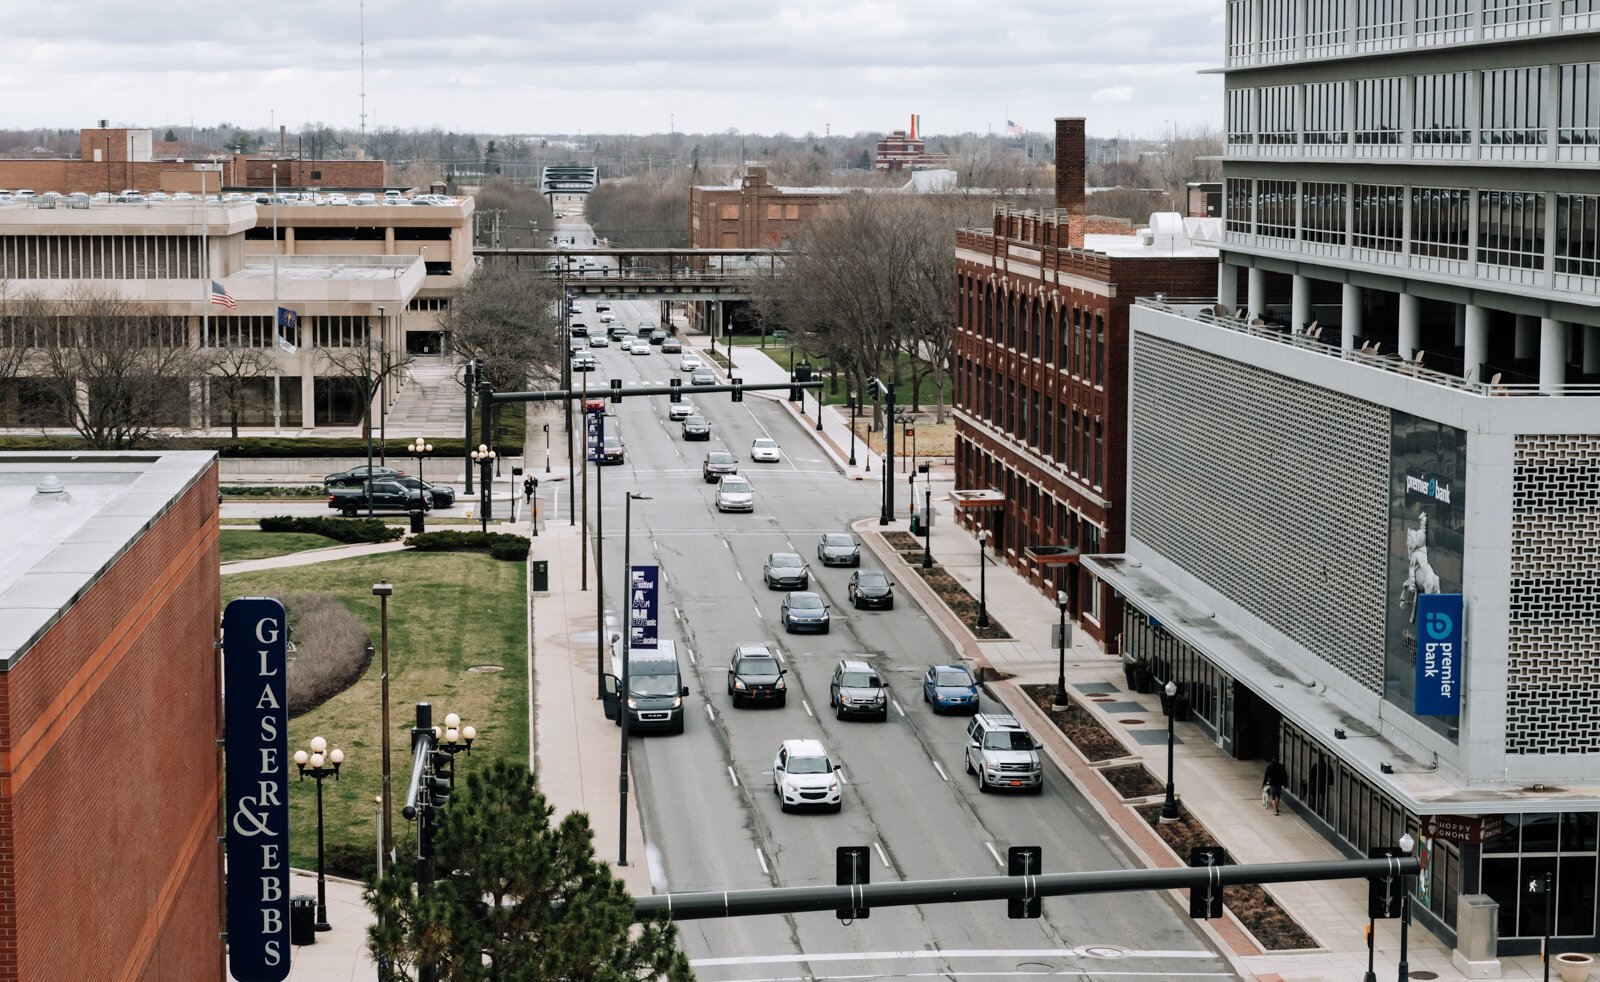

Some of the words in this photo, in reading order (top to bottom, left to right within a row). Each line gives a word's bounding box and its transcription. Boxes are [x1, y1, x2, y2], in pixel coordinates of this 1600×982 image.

[1406, 475, 1430, 495] premier
[1435, 479, 1451, 504] bank
[1424, 642, 1439, 678] bank
[1440, 642, 1455, 699] premier
[255, 617, 282, 807] GLASER
[232, 795, 279, 837] &
[1438, 829, 1471, 841] GNOME
[1439, 821, 1471, 832] HOPPY
[260, 844, 283, 967] EBBS
